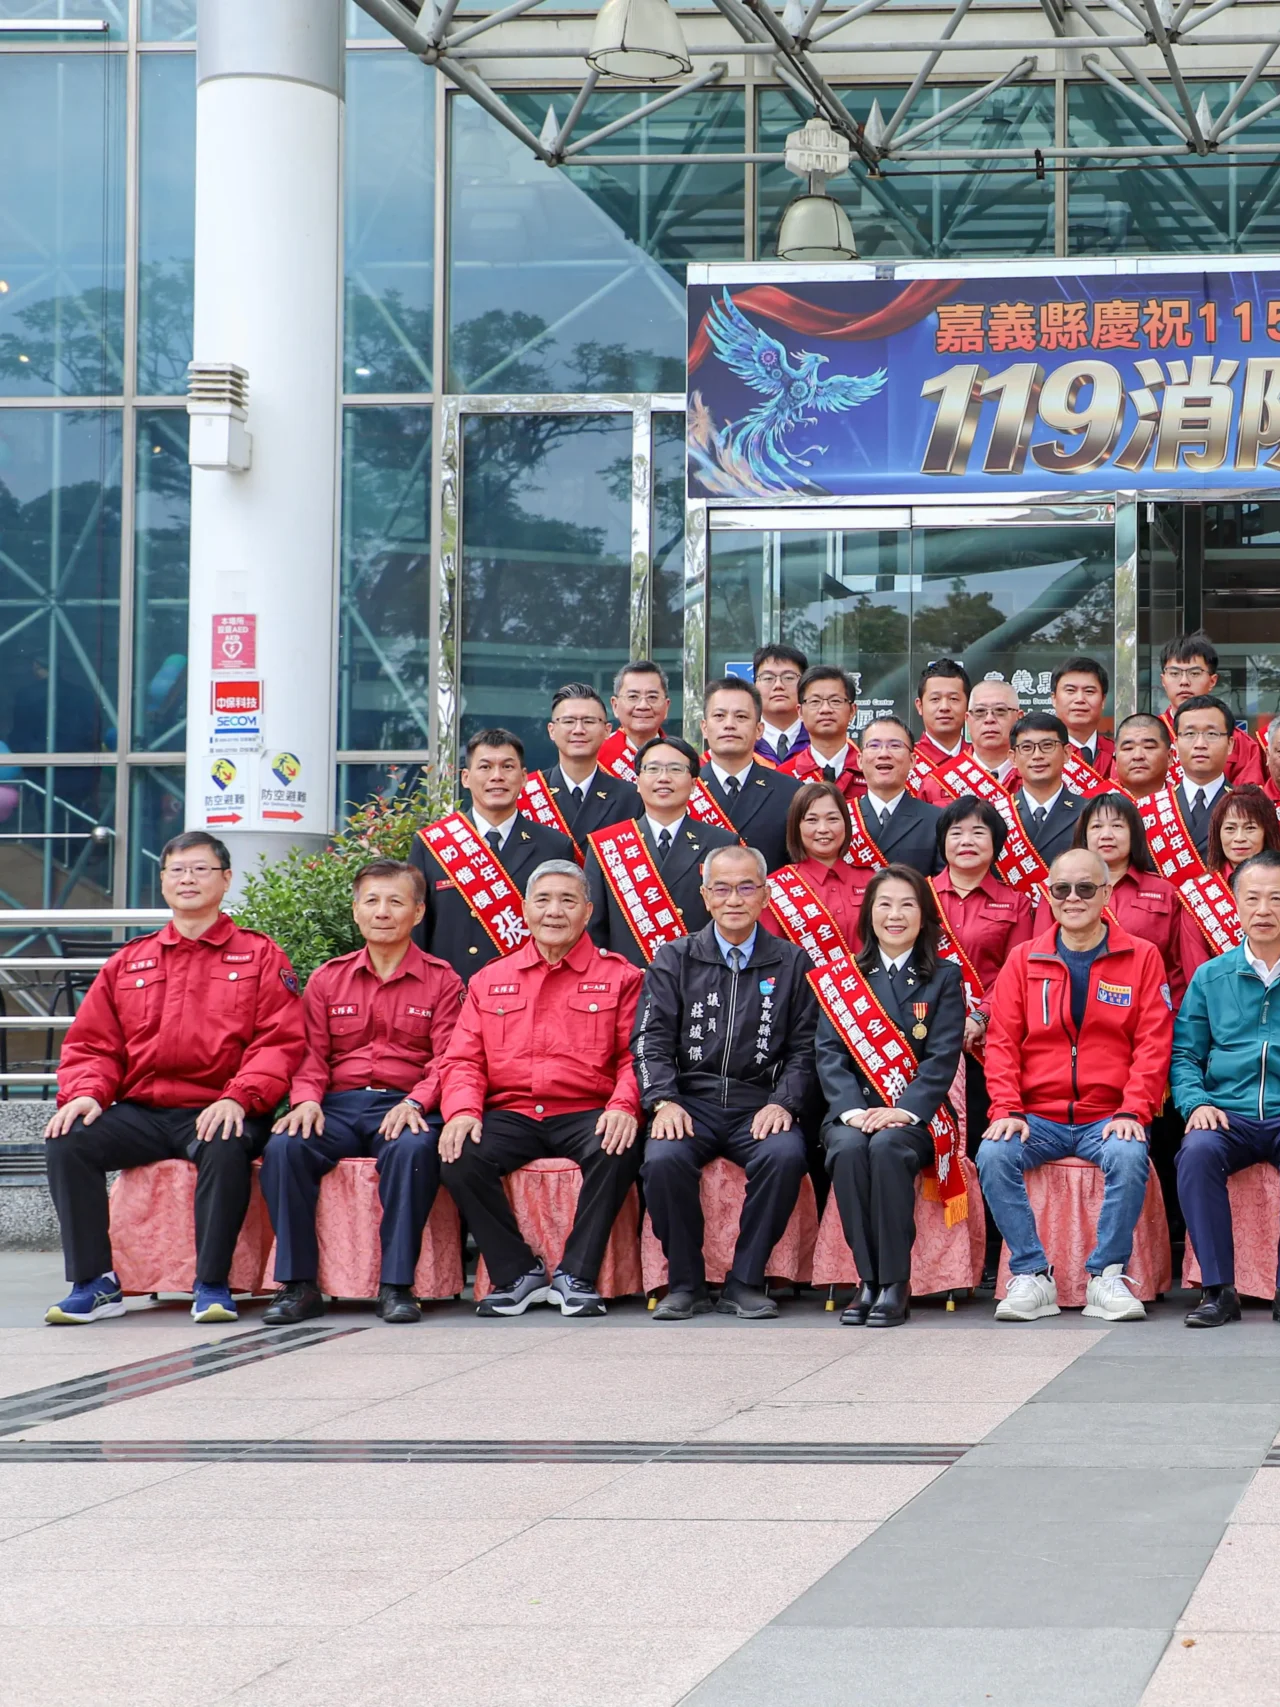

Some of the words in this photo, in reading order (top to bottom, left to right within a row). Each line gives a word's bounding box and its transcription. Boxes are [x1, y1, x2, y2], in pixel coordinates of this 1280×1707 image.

[216, 697, 258, 709] 中保科技
[216, 716, 257, 727] SECOM
[205, 794, 245, 806] 防空避難
[261, 789, 307, 802] 防空避難
[1154, 789, 1194, 868] 嘉義縣114年度
[425, 827, 493, 910] 消防楷模
[445, 819, 511, 900] 嘉義縣114年度
[1136, 795, 1178, 878] 消防楷模
[599, 839, 656, 937] 消防楷模鳳凰獎
[617, 832, 675, 927] 114年度全國
[777, 871, 845, 961] 114年度全國
[491, 905, 532, 948] 張
[706, 992, 720, 1034] 議員
[753, 996, 774, 1065] 嘉義縣議會
[818, 972, 886, 1074] 義消楷模鳳凰獎
[831, 960, 904, 1061] 114年度全國
